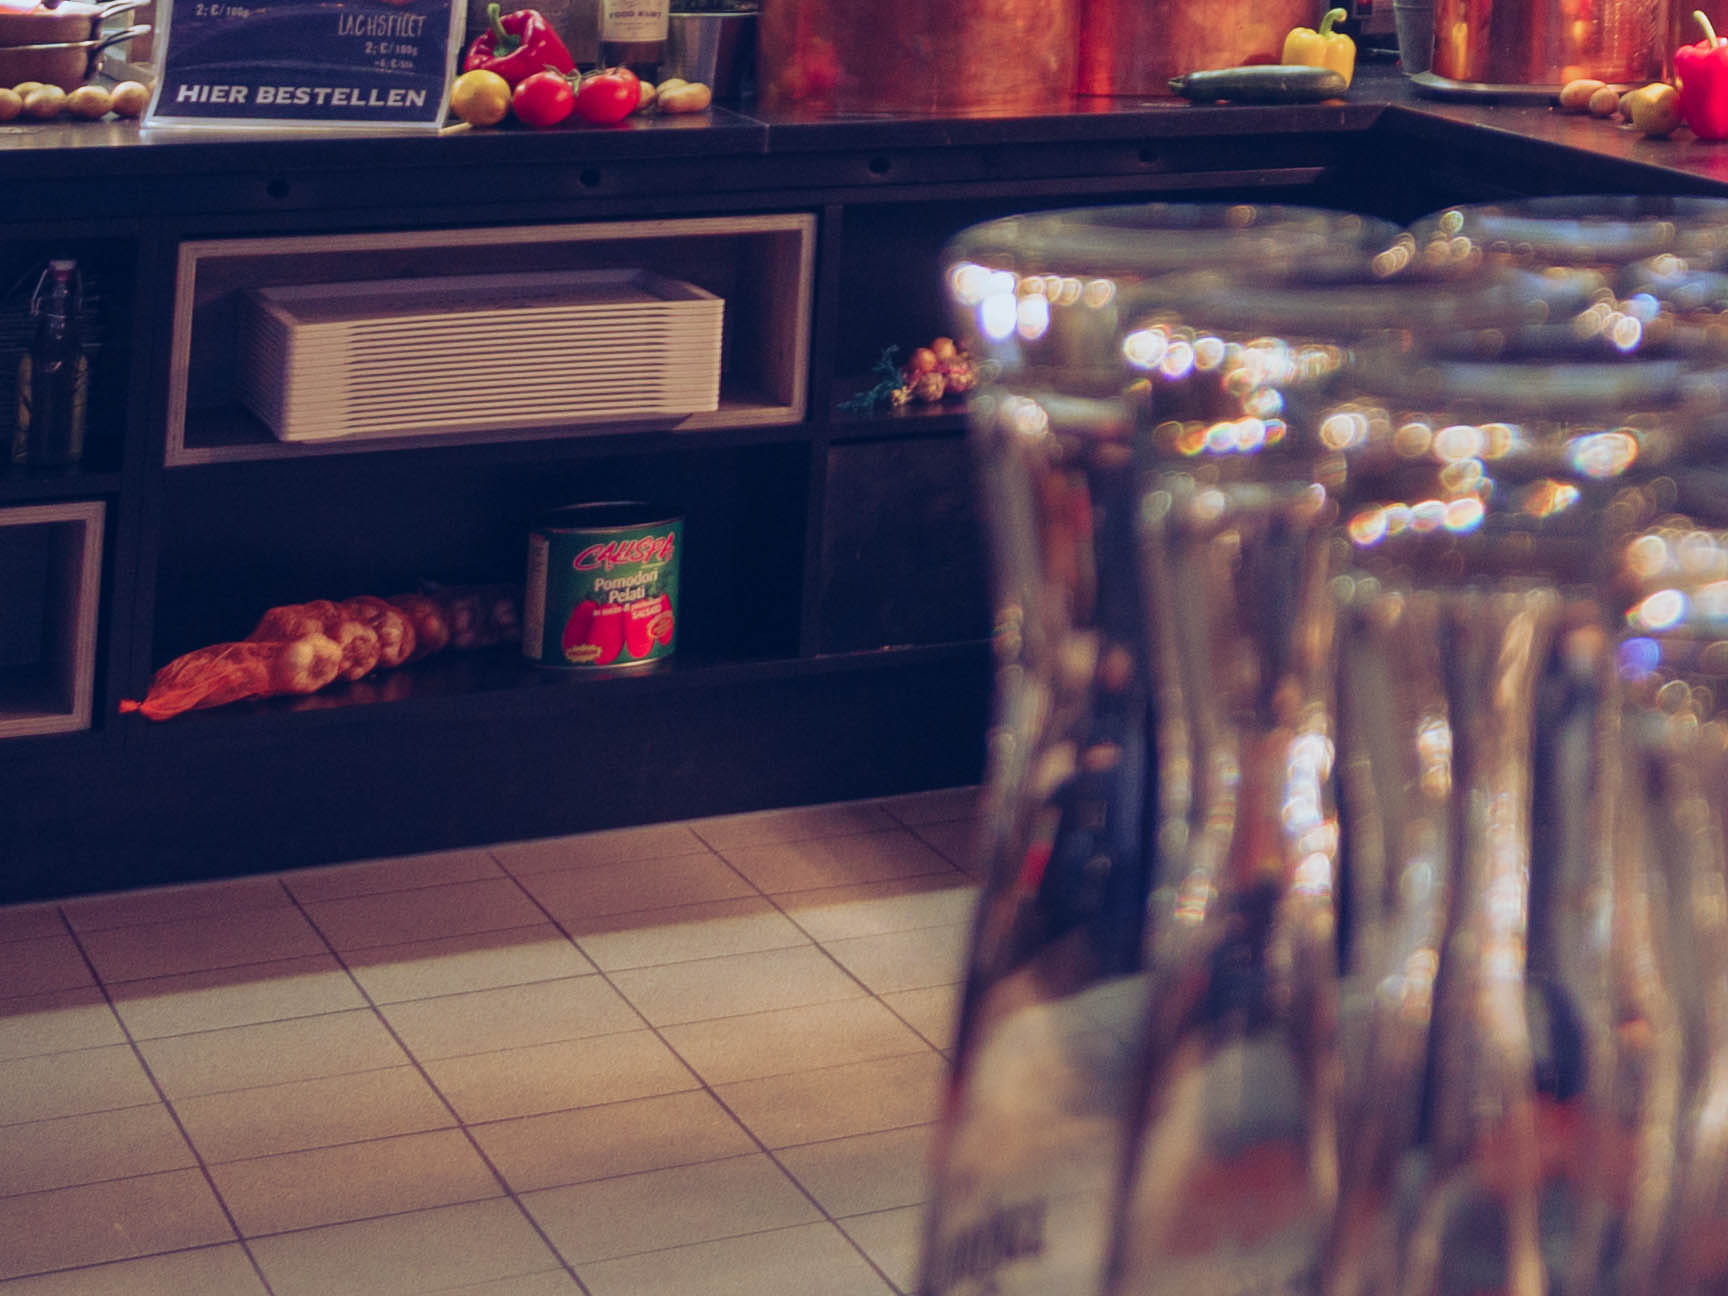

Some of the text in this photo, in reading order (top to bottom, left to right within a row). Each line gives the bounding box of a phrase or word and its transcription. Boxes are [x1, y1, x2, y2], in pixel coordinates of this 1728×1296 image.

[337, 11, 428, 38] LACHSFILET
[175, 84, 427, 108] HIER BESTELLEN
[593, 567, 659, 592] Pomodori
[608, 584, 646, 605] Pelati
